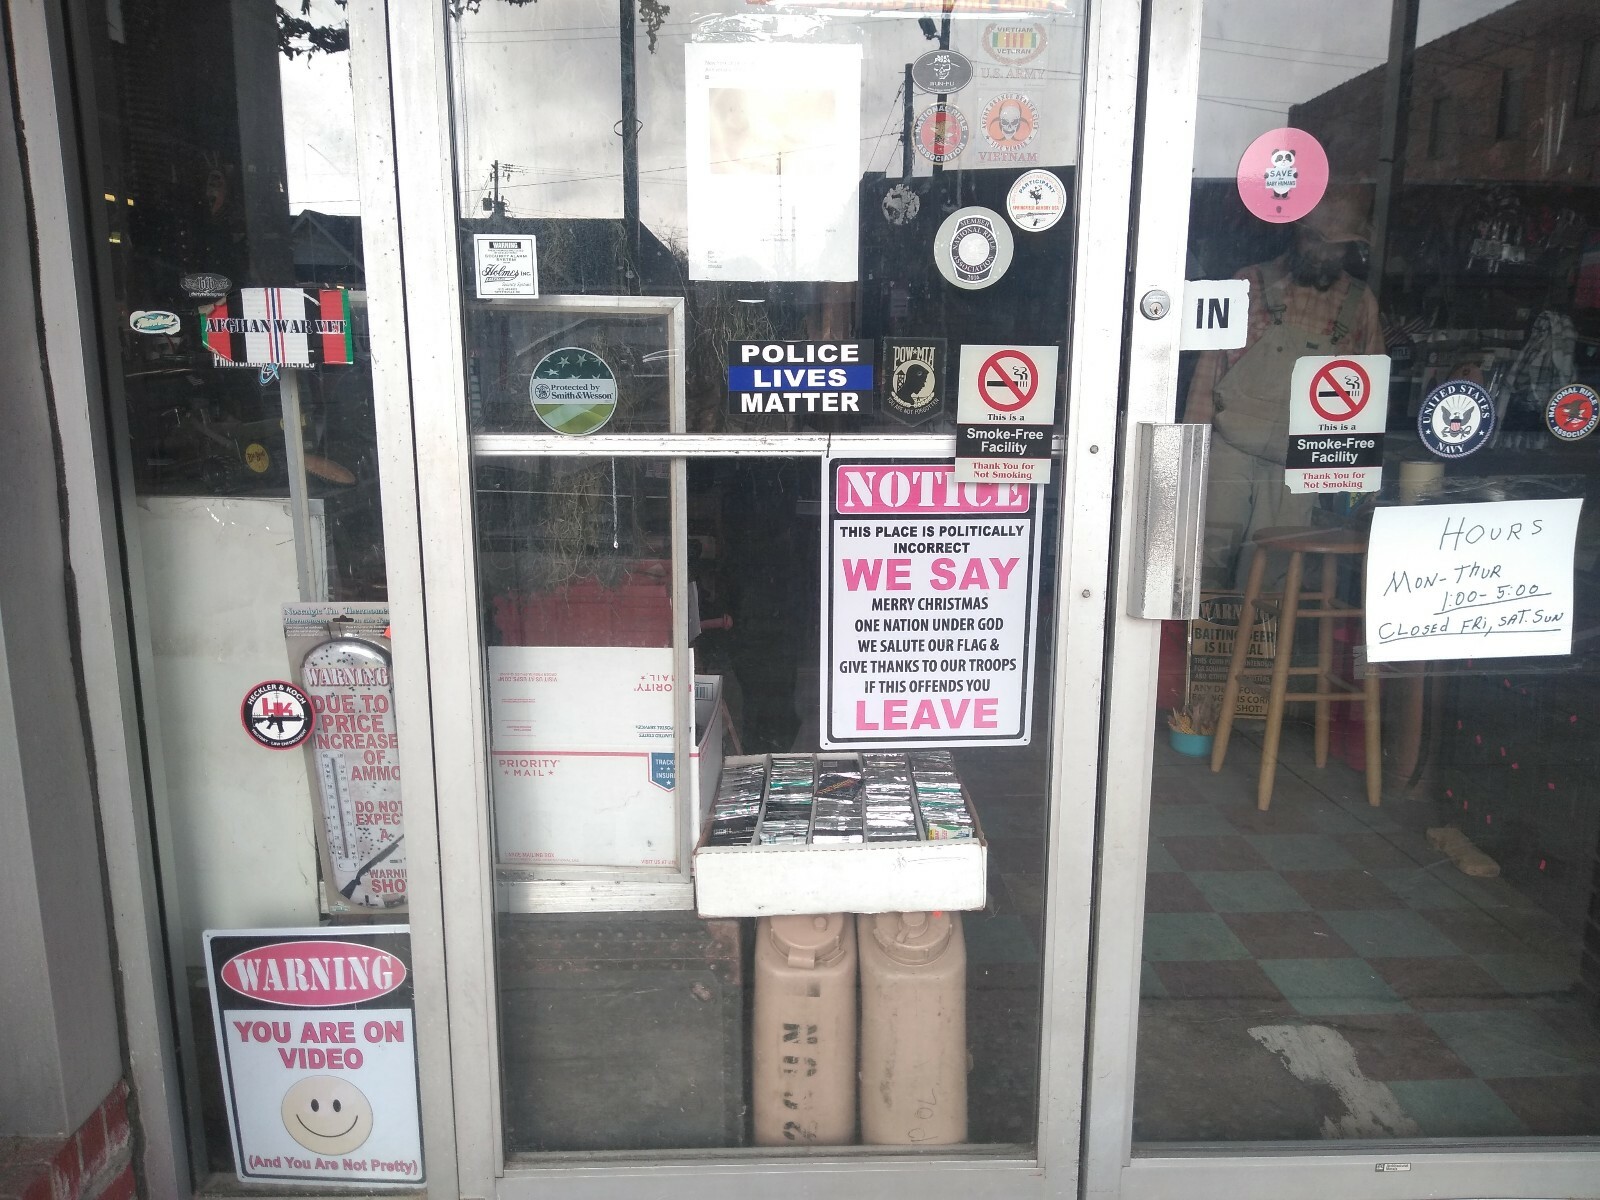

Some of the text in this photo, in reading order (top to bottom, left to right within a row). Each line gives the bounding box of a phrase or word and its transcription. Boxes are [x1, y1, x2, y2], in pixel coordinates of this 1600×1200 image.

[980, 67, 1046, 79] U.S. ARMY
[915, 105, 968, 132] NATIONAL RIFLE
[917, 142, 965, 162] ASSOCIATION
[978, 151, 1038, 162] VIETNAM
[1018, 179, 1056, 194] PARTICIPANT
[960, 218, 990, 228] MEMBER
[952, 227, 996, 250] NATIONAL RIFLE
[953, 255, 994, 272] ASSOCIATION
[1196, 297, 1230, 329] IN
[205, 317, 348, 335] AFGHAN WAR VET
[741, 344, 859, 363] POLICE
[893, 346, 914, 371] POW
[754, 368, 847, 388] LIVES
[590, 384, 600, 392] by
[741, 391, 860, 413] MATTER
[903, 407, 914, 415] NOT
[914, 397, 940, 415] FORGOTTEN
[1422, 384, 1490, 424] UNITED STATES
[1548, 387, 1598, 418] NATIONAL RIFLE
[987, 413, 1007, 421] This
[1009, 413, 1017, 421] is
[1340, 423, 1349, 431] is
[1552, 414, 1598, 438] ASSOCIATION
[966, 428, 1044, 440] Smoke-Free
[981, 441, 1027, 455] Facility
[1297, 437, 1375, 450] Smoke-Free
[1436, 442, 1465, 454] NAVY
[1311, 450, 1358, 464] Facility
[972, 462, 1001, 470] Thank
[973, 471, 1033, 480] Not Smoking
[1302, 471, 1366, 480] Thank You for
[844, 471, 1023, 508] NOTICE
[1303, 480, 1363, 489] Not Smoking
[840, 525, 1025, 538] THIS PLACE IS POLITICALLY
[1439, 517, 1543, 551] HOURS
[893, 542, 970, 554] INCORRECT
[842, 557, 1020, 591] WE SAY
[1496, 583, 1539, 600] 5:00
[871, 597, 989, 611] MERRY CHRISTMAS
[283, 607, 323, 617] Nostalgic
[854, 617, 1004, 632] ONE NATION UNDER GOD
[1194, 628, 1237, 641] BAITIN
[857, 638, 1000, 652] WE SALUTE OUR FLAG &
[839, 658, 1017, 673] GIVE THANKS TO OUR TROOPS
[303, 667, 389, 687] WARNING
[864, 679, 991, 694] IF THIS OFFENDS YOU
[248, 684, 277, 705] HECKLER
[286, 686, 307, 705] KOCH
[311, 694, 389, 714] DUE TO
[1236, 705, 1263, 713] SHOT!
[856, 698, 999, 731] LEAVE
[322, 714, 385, 733] PRICE
[363, 749, 386, 765] OF
[499, 759, 559, 768] PRIORITY
[351, 765, 401, 781] AMMO
[513, 769, 545, 777] MAIL
[355, 800, 375, 813] DO
[355, 813, 402, 826] EXPEC
[381, 828, 389, 840] A
[371, 879, 407, 893] SHO
[233, 956, 393, 991] WARNING
[233, 1020, 405, 1043] YOU ARE ON
[277, 1048, 364, 1070] VIDEO
[248, 1155, 418, 1175] (And You Are Not Pretty)
